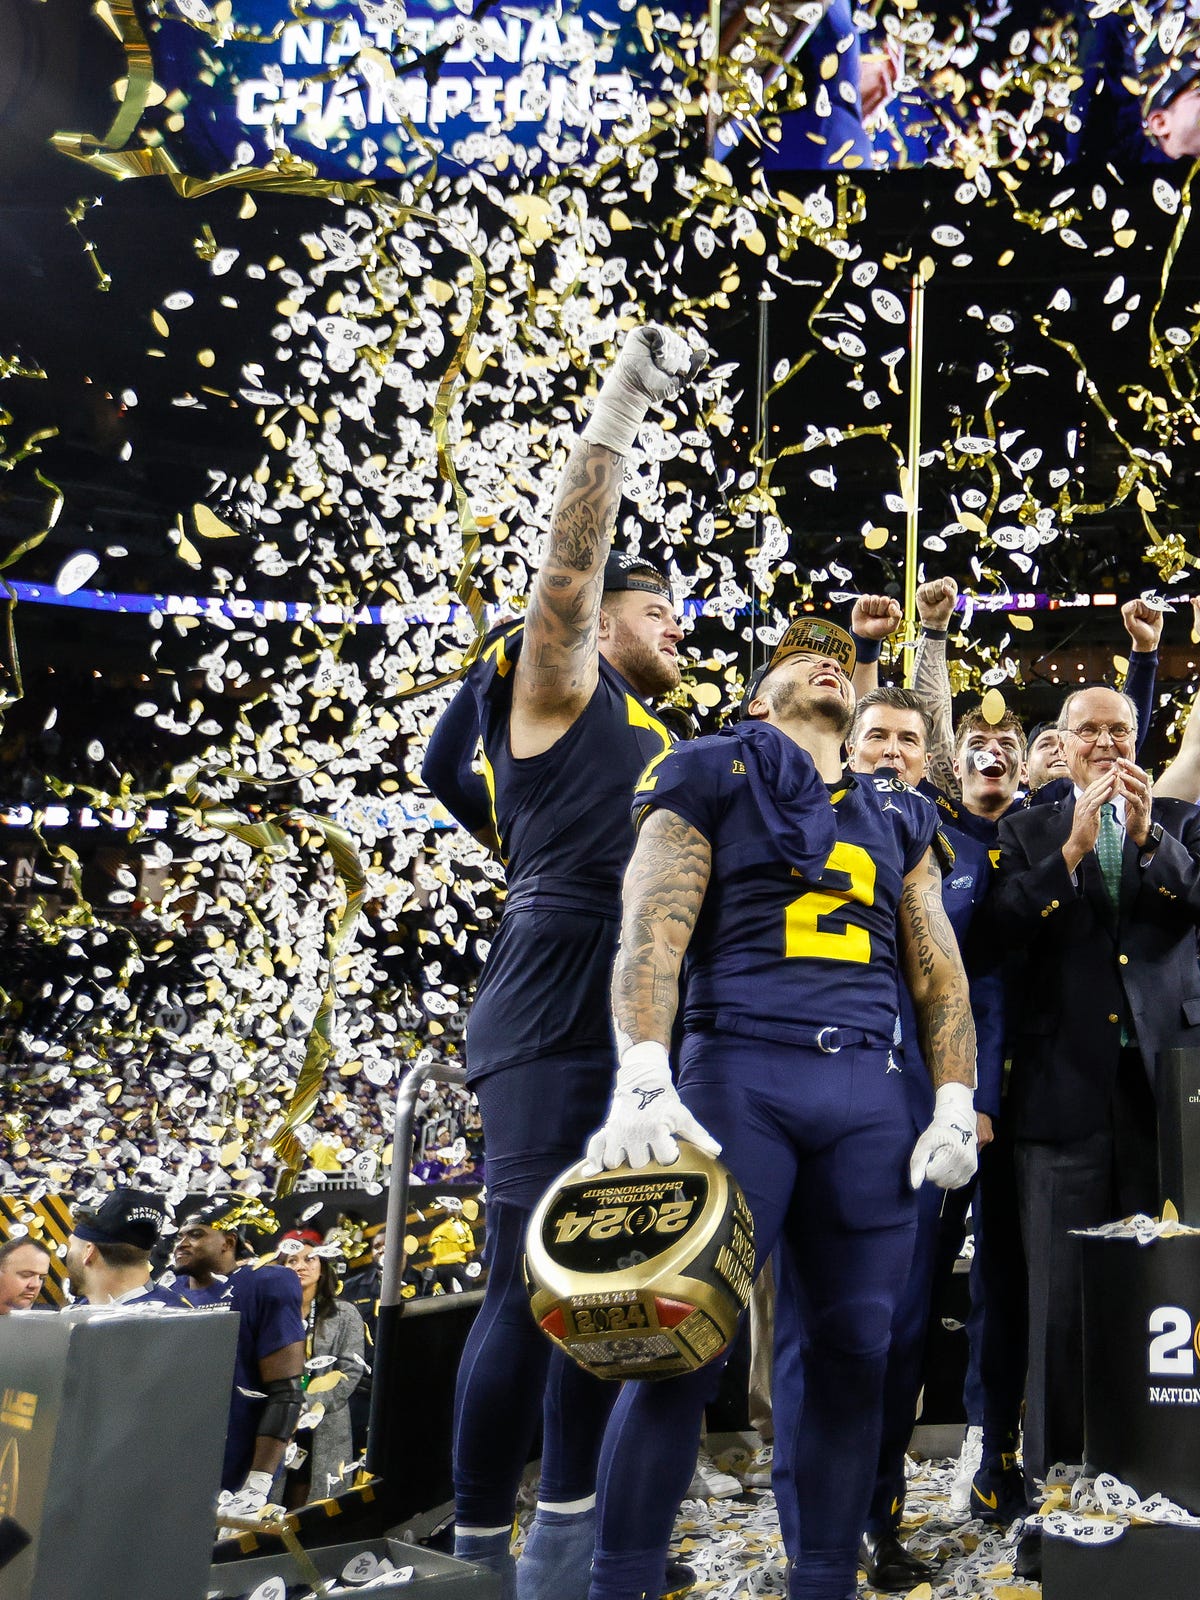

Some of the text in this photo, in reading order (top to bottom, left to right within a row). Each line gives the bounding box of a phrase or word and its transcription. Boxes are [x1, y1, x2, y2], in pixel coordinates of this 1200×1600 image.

[237, 76, 635, 125] CHAMPIONS
[783, 630, 853, 665] CHAMPS
[784, 840, 878, 964] 2
[583, 1180, 684, 1199] CHAMPIONSHIP
[597, 1190, 664, 1206] NATIONAL
